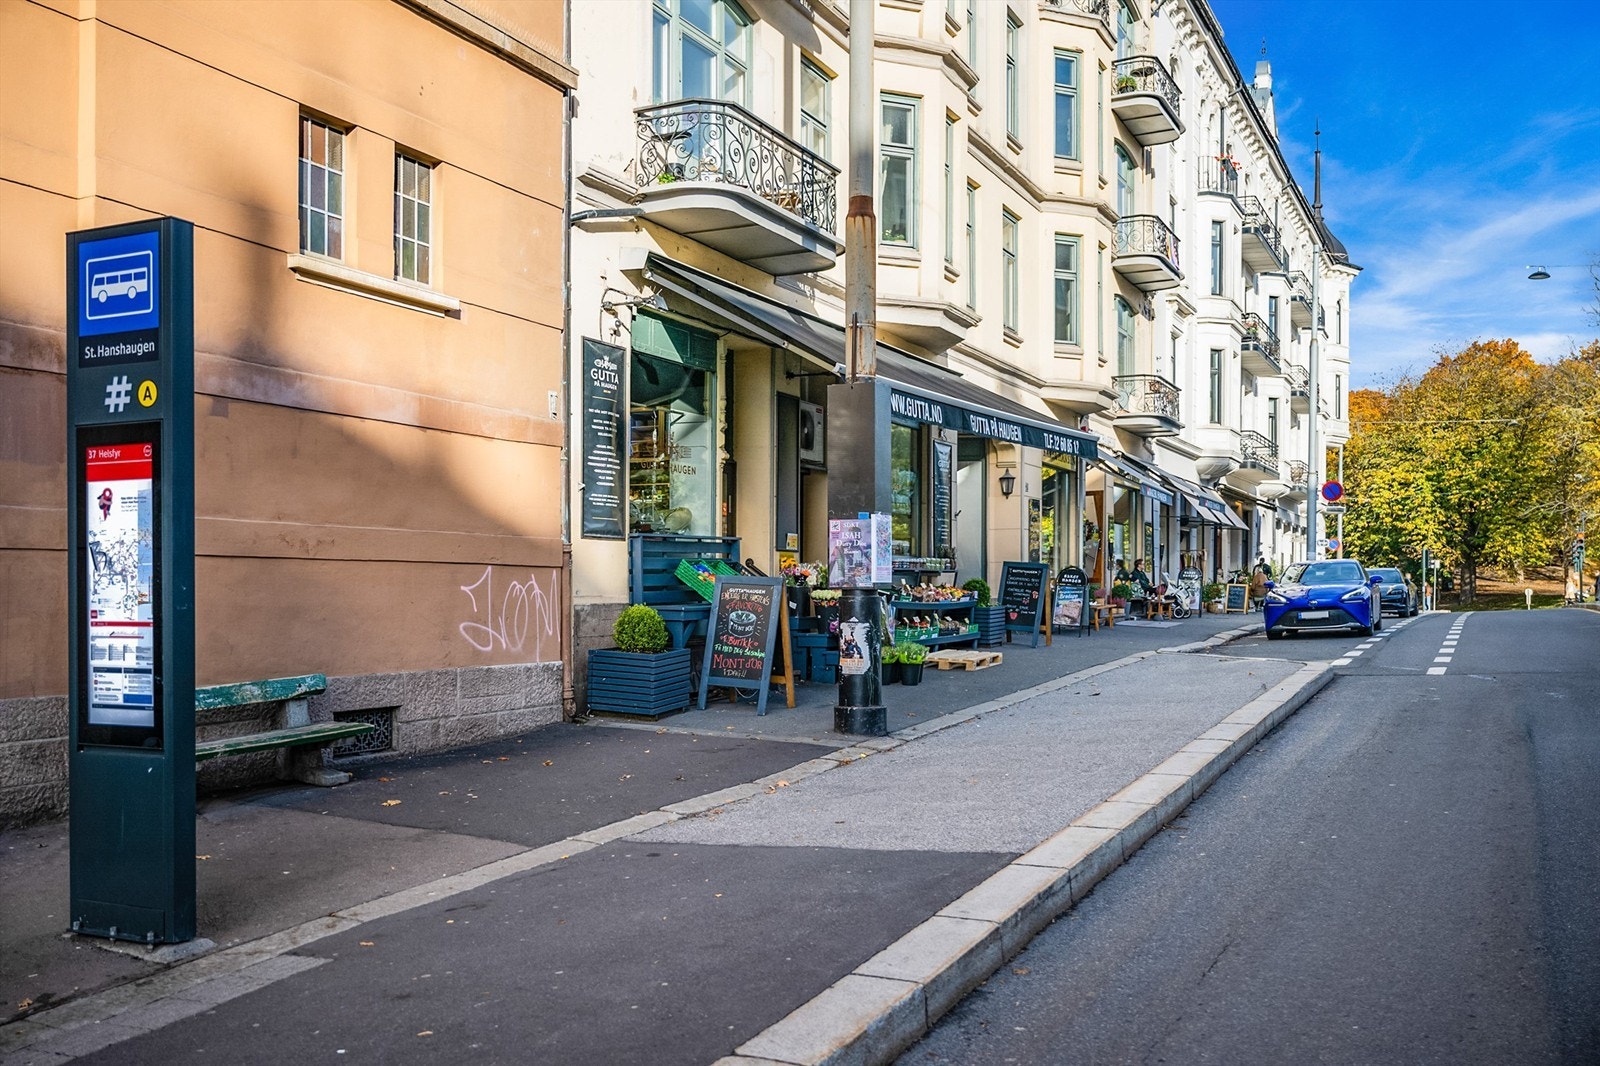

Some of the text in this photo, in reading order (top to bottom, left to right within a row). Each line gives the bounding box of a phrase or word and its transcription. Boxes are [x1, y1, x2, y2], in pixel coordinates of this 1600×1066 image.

[84, 342, 155, 359] St. Hanshaugen
[590, 368, 619, 384] GUTTA
[143, 385, 153, 401] A
[970, 414, 991, 436] GUTTA
[990, 416, 999, 438] PÅ
[998, 421, 1022, 442] HAUGEN
[88, 448, 121, 459] 37 Helsfyr
[712, 654, 745, 669] MONT
